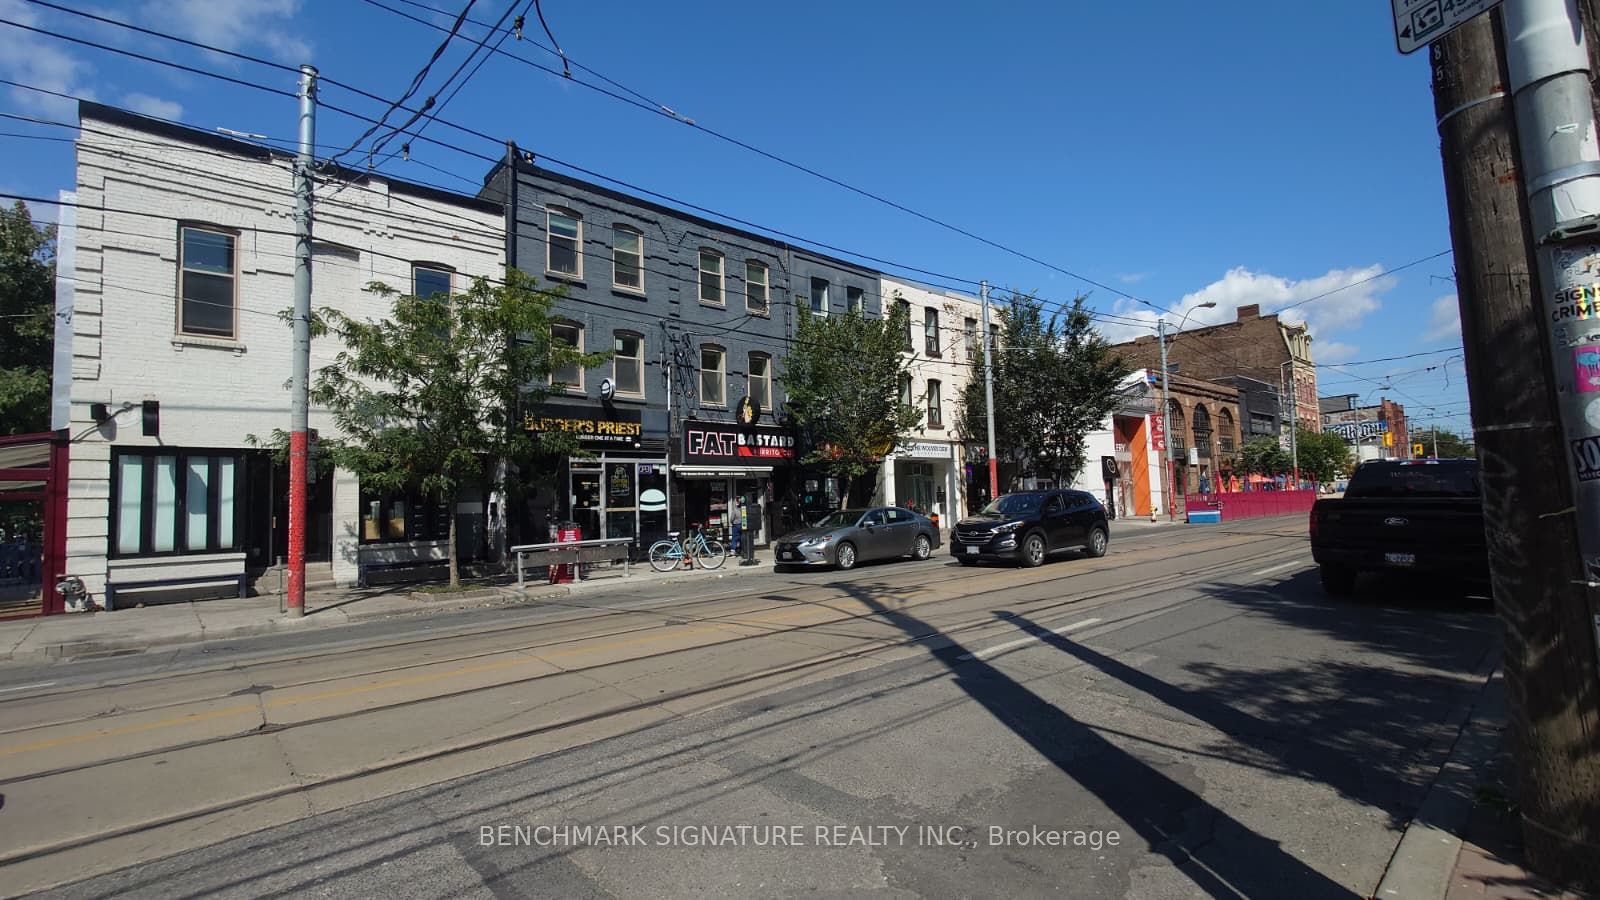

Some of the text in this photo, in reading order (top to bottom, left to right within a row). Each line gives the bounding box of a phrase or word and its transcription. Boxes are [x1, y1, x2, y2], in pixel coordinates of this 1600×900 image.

[597, 420, 641, 436] PRIEST
[688, 430, 794, 456] FAT BASTARD
